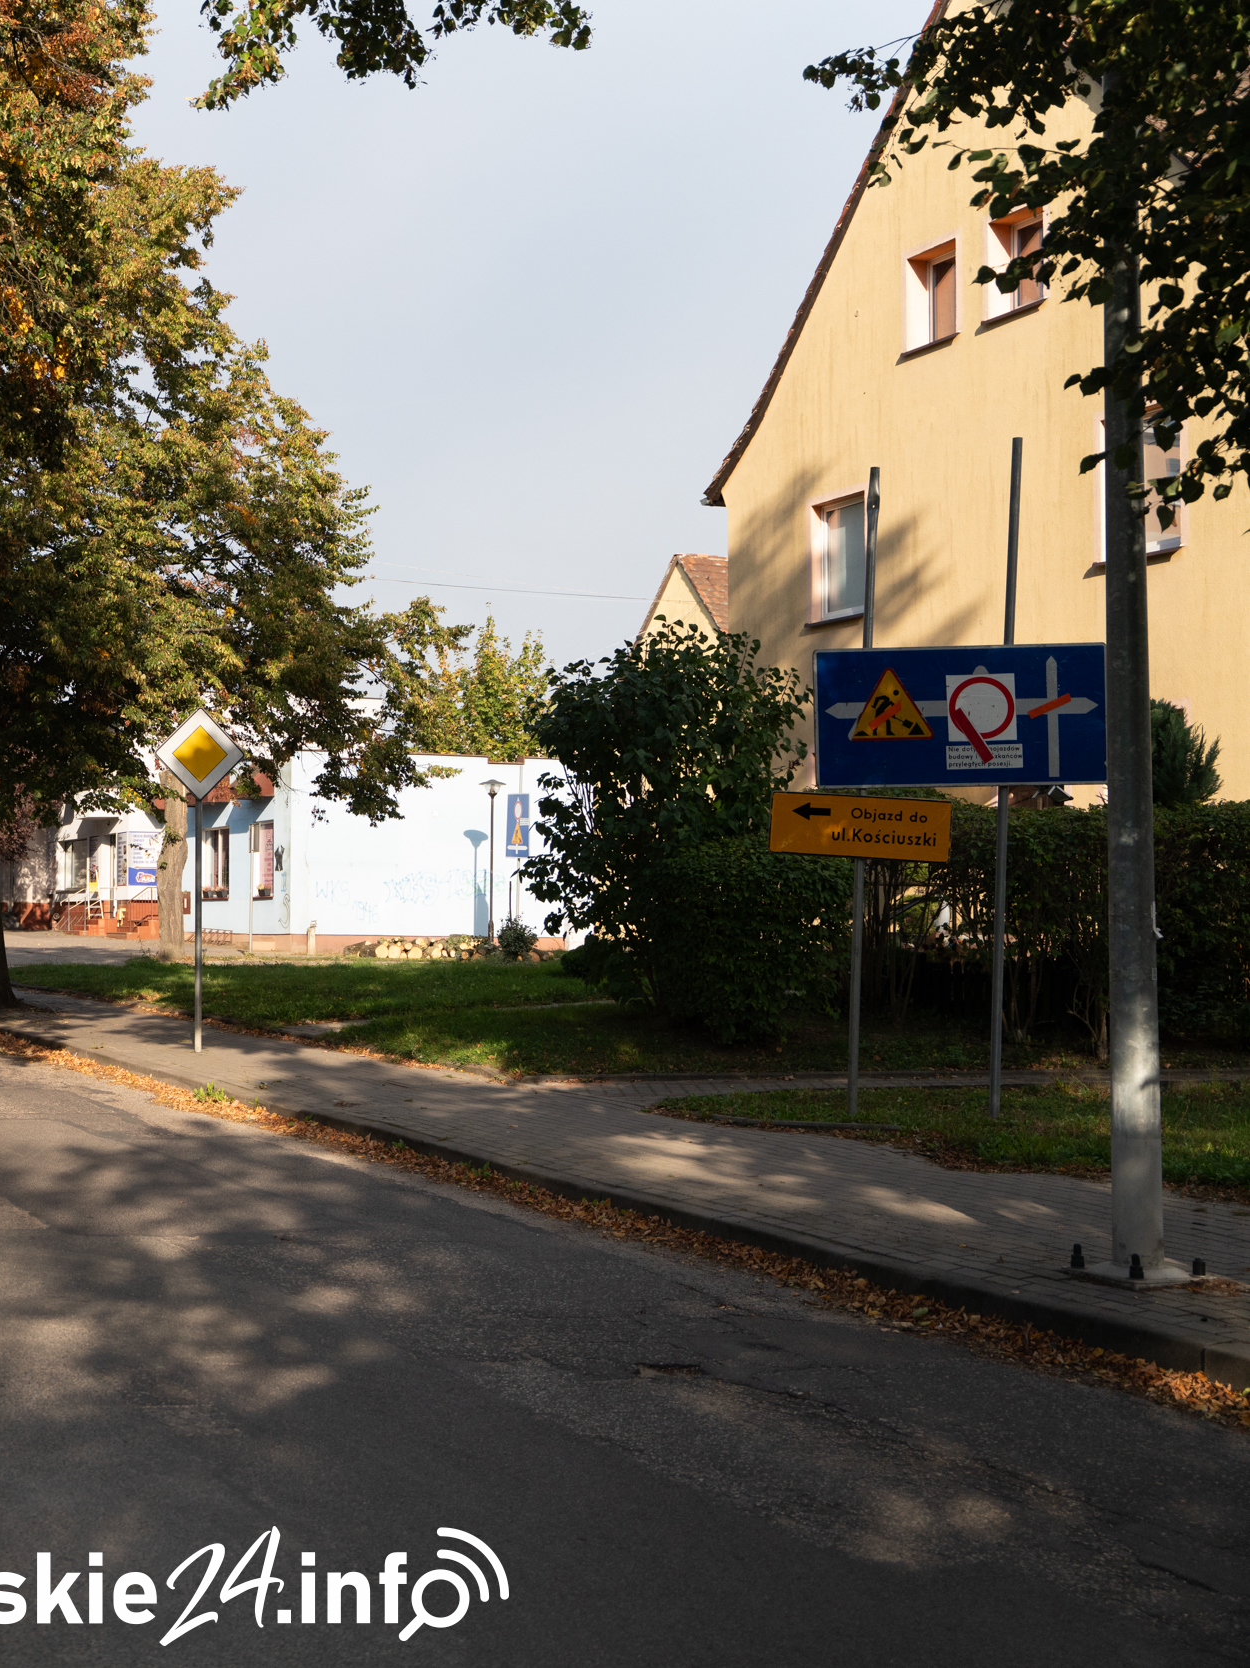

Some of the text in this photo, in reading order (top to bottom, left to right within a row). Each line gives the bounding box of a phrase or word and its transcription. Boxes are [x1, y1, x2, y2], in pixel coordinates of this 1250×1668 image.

[851, 807, 928, 823] Objazd do
[831, 828, 937, 847] ul.Kościuszki
